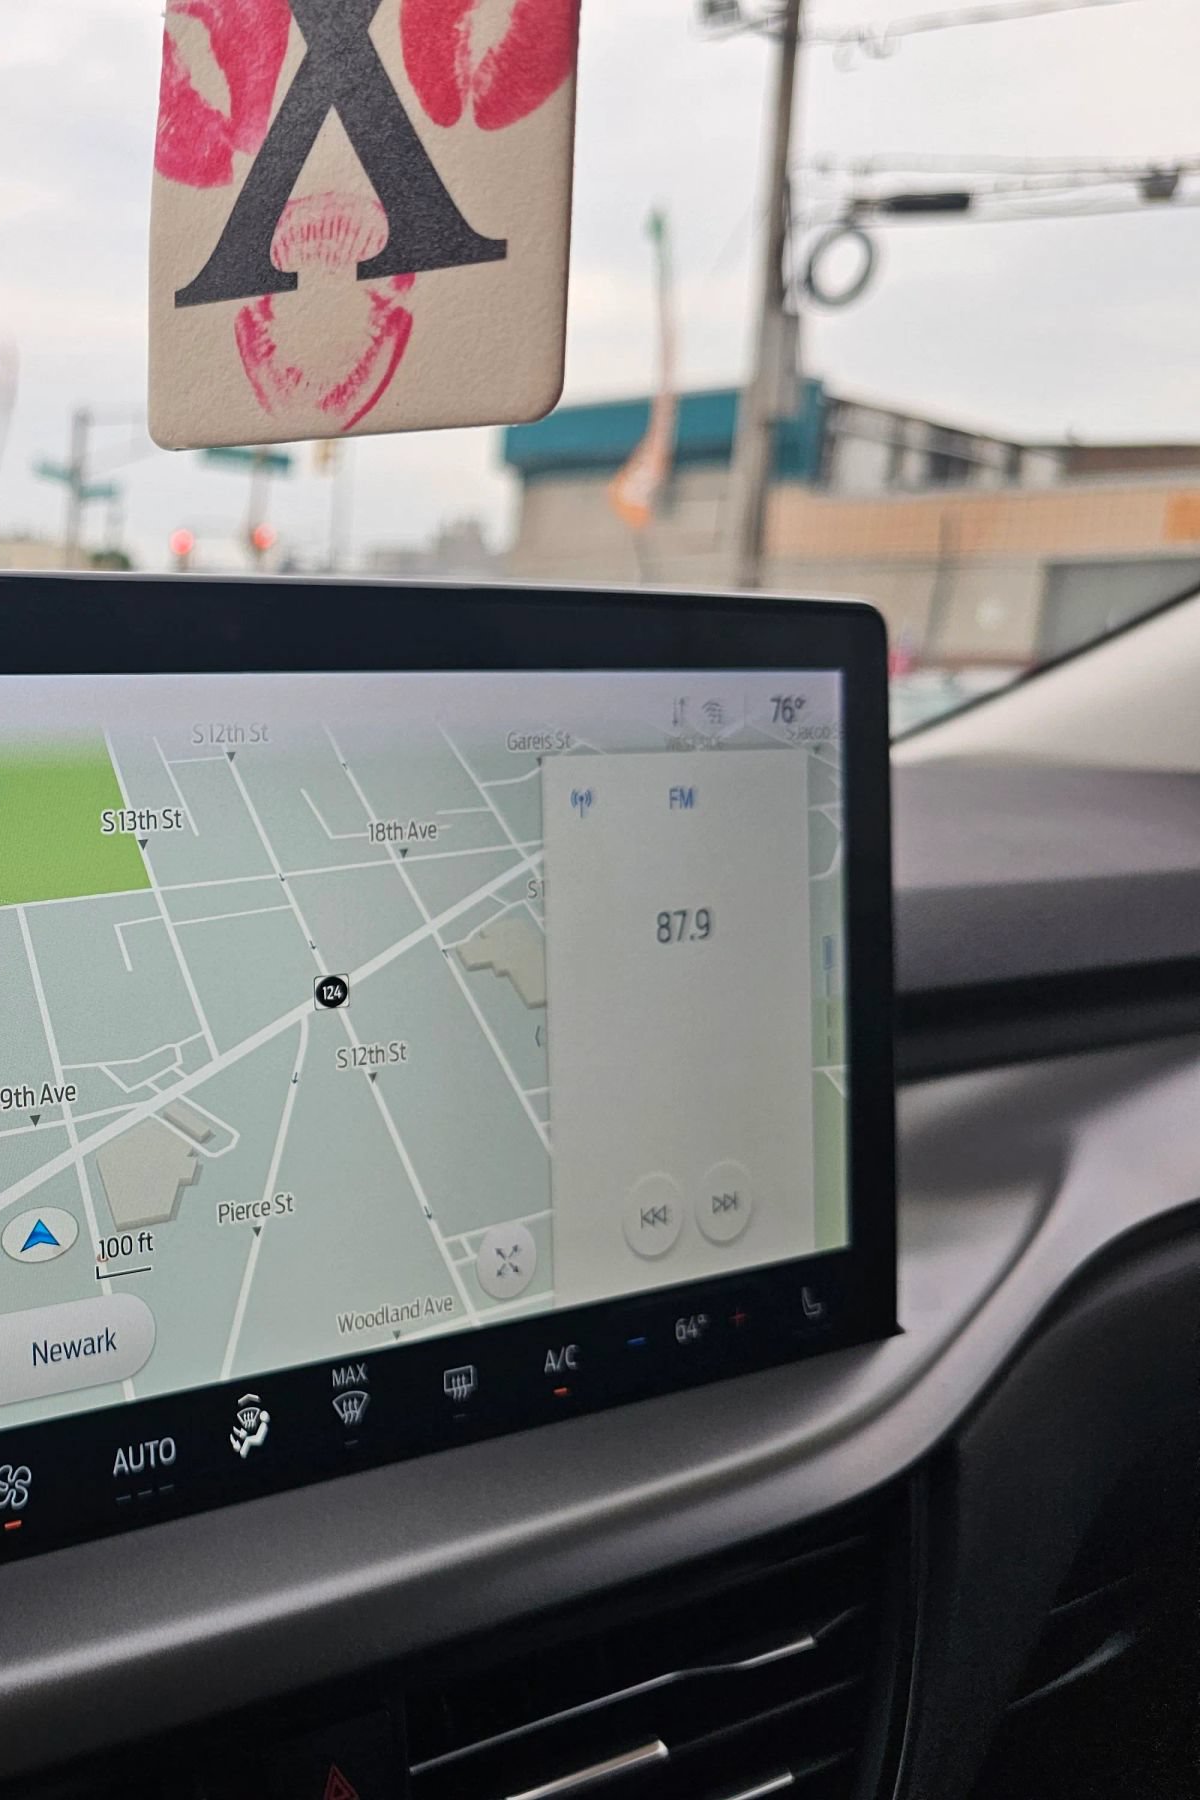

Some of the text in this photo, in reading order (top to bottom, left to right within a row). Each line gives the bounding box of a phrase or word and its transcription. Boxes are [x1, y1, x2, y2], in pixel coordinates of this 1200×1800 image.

[175, 0, 507, 309] X
[192, 721, 269, 744] S 12th St
[506, 730, 571, 751] Gareis St
[668, 788, 695, 811] FM
[102, 810, 183, 833] S 13th St
[368, 821, 438, 842] 18th Ave
[656, 908, 712, 944] 87.9
[322, 984, 343, 1001] 124
[336, 1042, 408, 1070] S 12th St
[40, 1084, 78, 1106] Ave
[217, 1194, 295, 1224] Pierce St
[99, 1234, 154, 1259] 100 ft
[337, 1296, 453, 1334] Woodland Ave
[31, 1327, 118, 1367] Newark
[544, 1345, 578, 1373] A/C
[331, 1362, 368, 1388] MAX
[113, 1437, 177, 1477] AUTO
